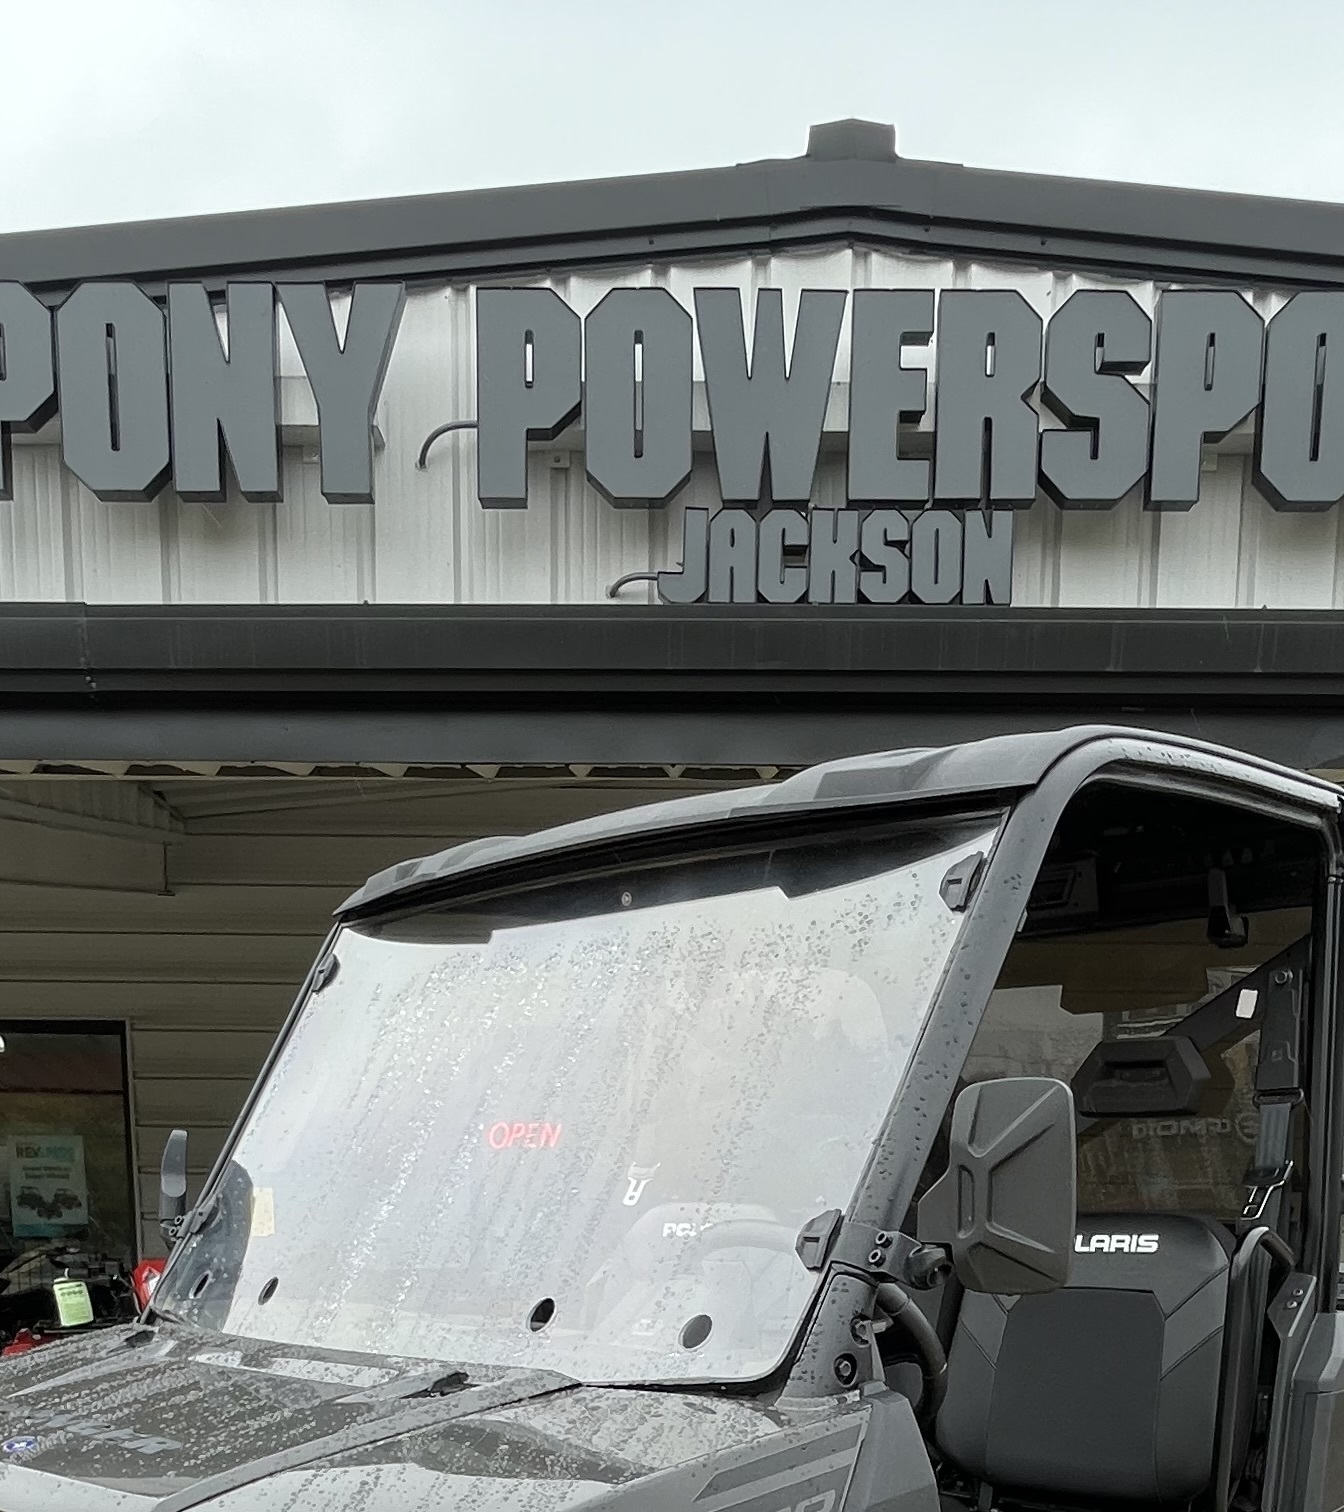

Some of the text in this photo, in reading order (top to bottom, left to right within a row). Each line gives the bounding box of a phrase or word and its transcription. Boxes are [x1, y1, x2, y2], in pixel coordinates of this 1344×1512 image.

[657, 505, 1013, 605] JACKSON
[487, 1120, 563, 1150] OPEN
[1074, 1233, 1160, 1253] LARIS
